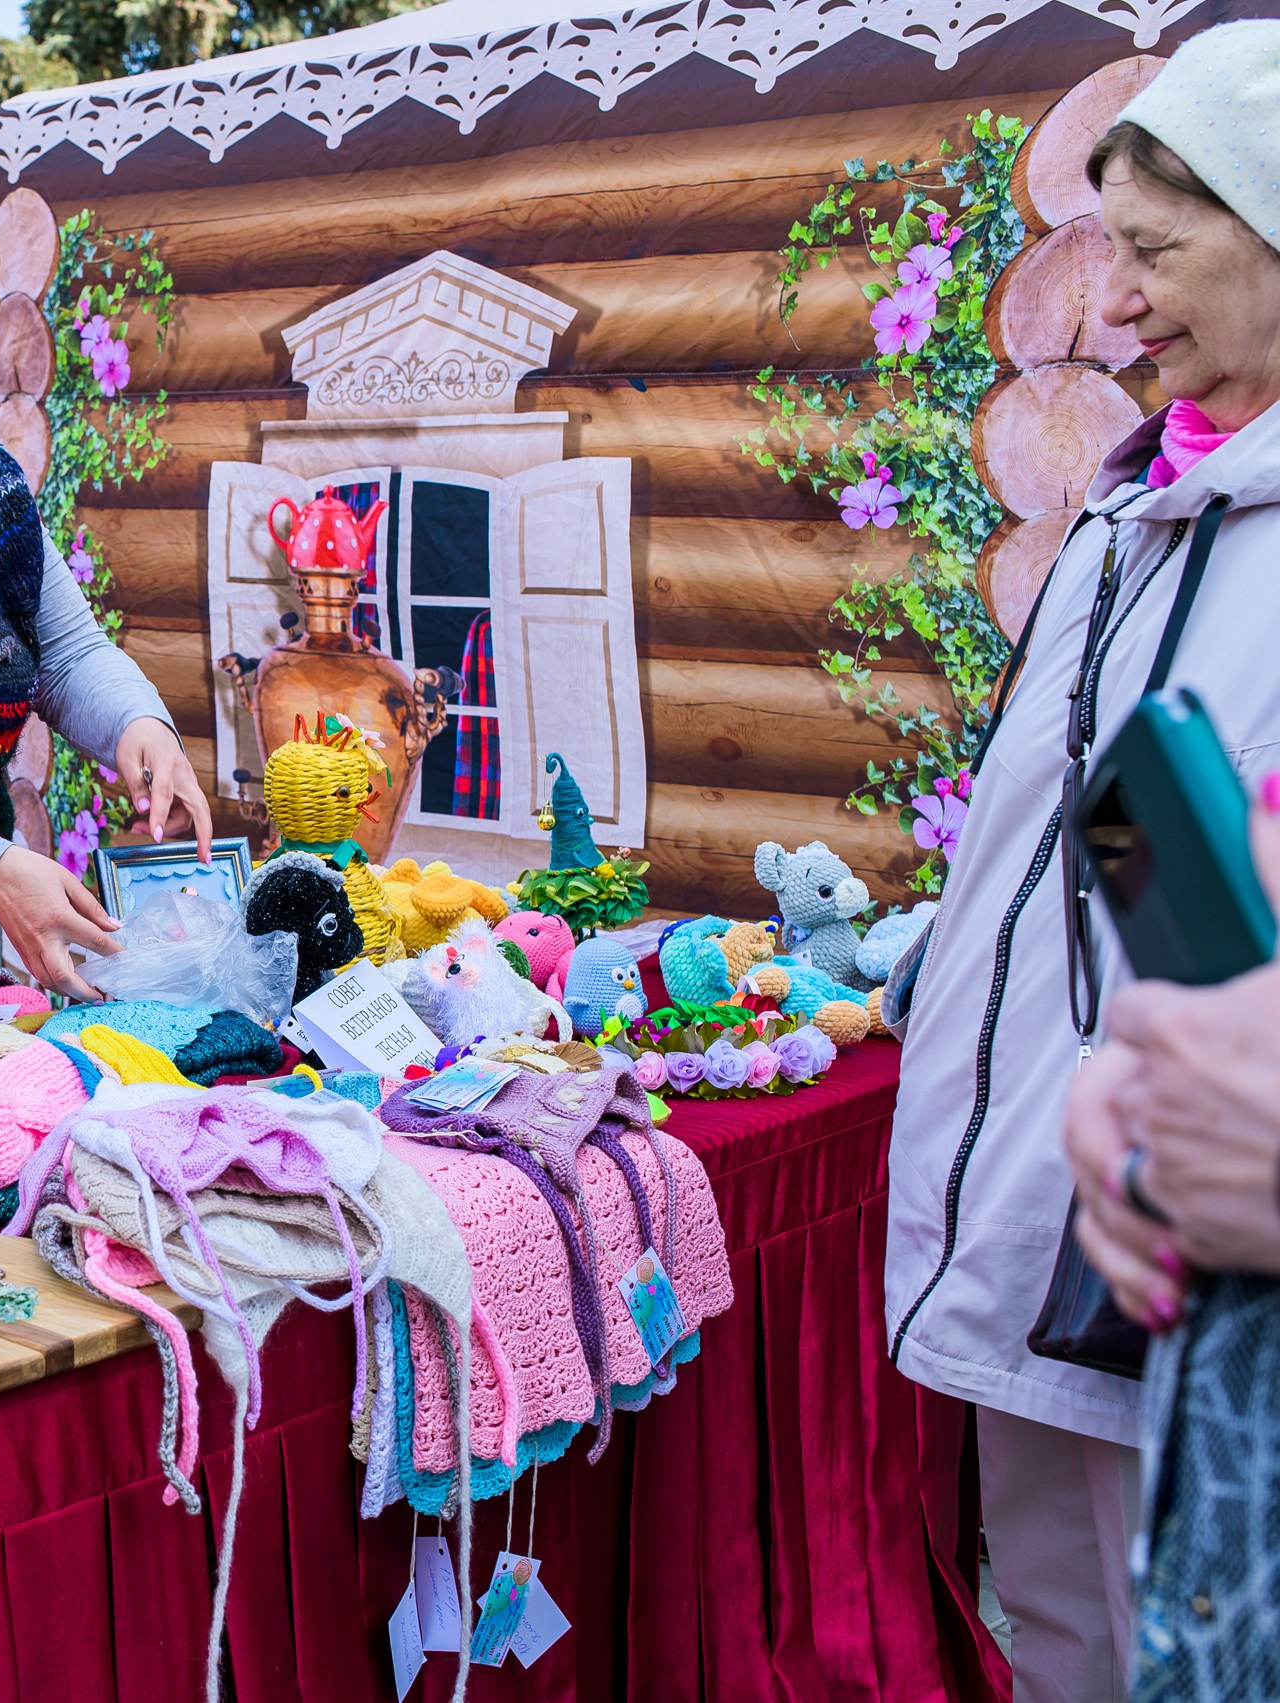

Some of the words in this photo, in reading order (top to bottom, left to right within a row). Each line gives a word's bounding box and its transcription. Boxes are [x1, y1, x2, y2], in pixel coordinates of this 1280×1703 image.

[327, 975, 366, 1009] СОВЕТ
[339, 992, 399, 1040] ВЕТЕРАНОВ
[374, 1023, 417, 1061] ЛЕСНАЯ
